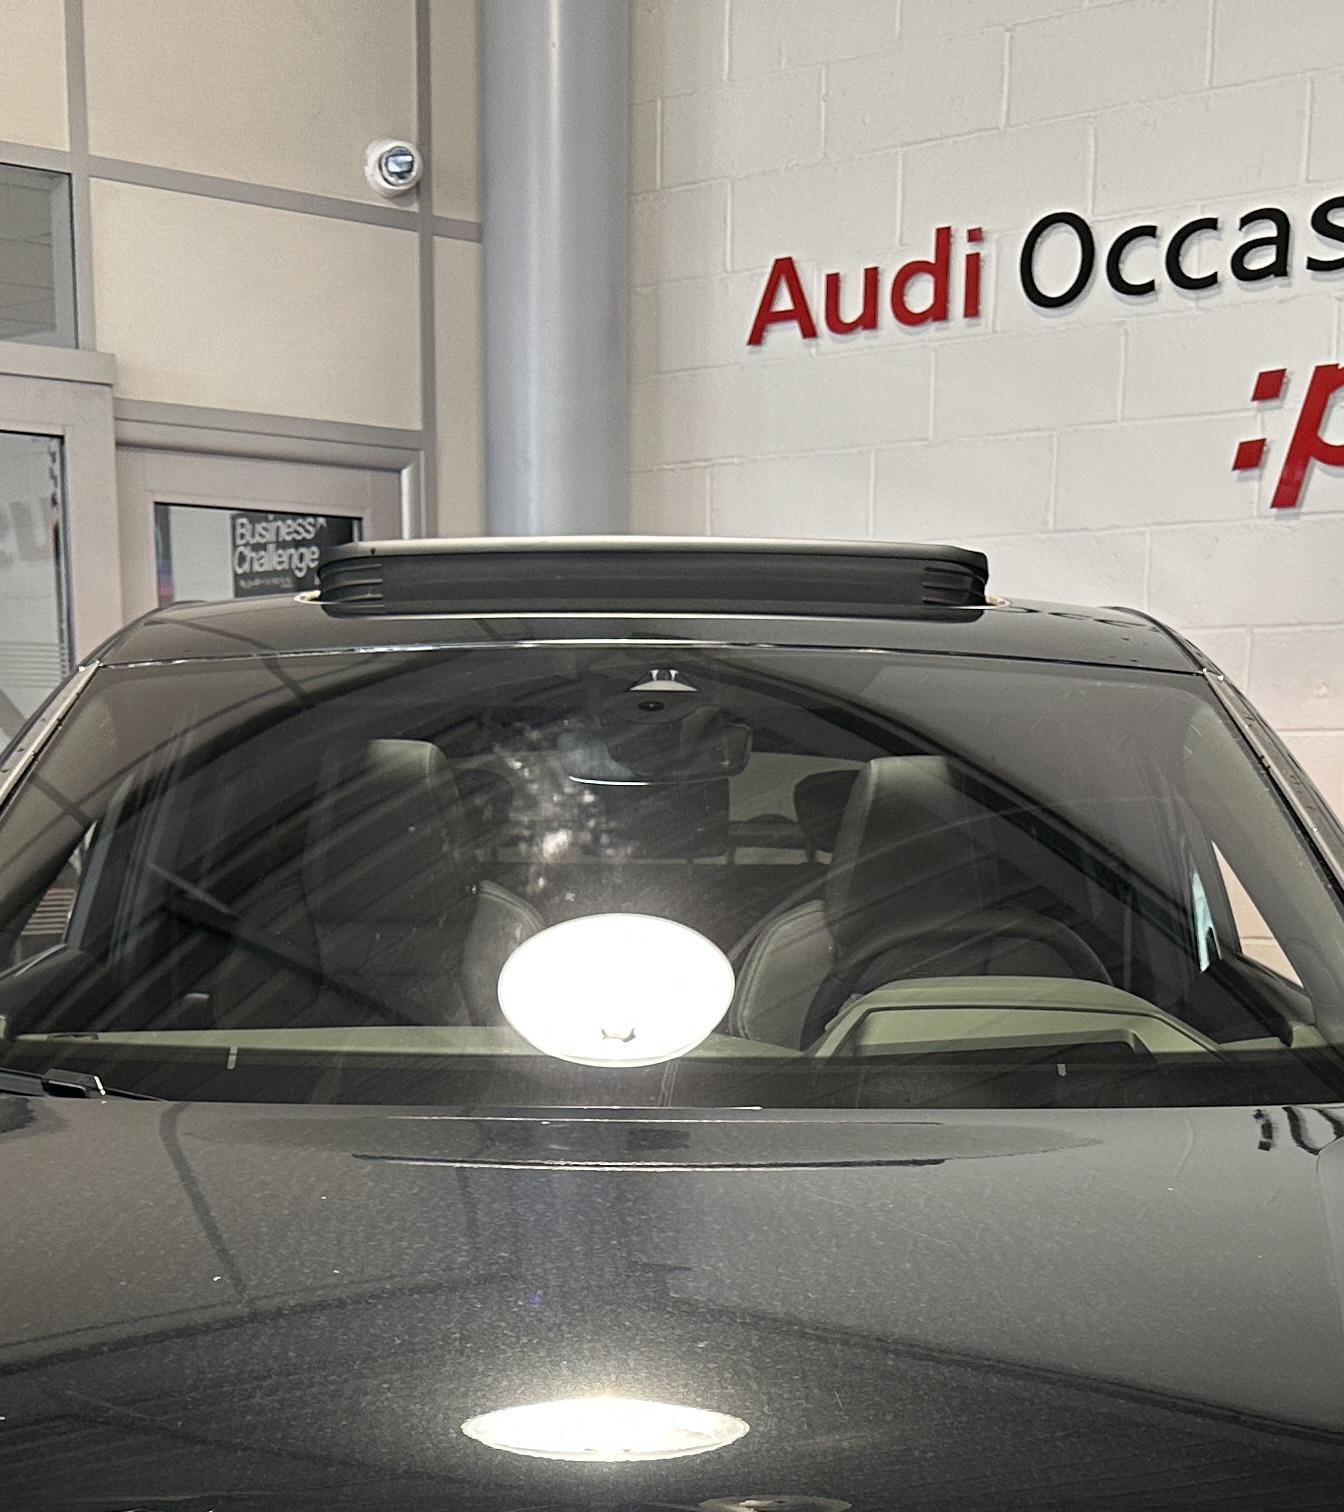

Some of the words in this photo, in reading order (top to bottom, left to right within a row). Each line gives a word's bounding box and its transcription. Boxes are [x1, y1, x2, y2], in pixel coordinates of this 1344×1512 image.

[747, 226, 982, 345] Audi
[235, 514, 317, 547] Business
[234, 544, 321, 578] Challenge
